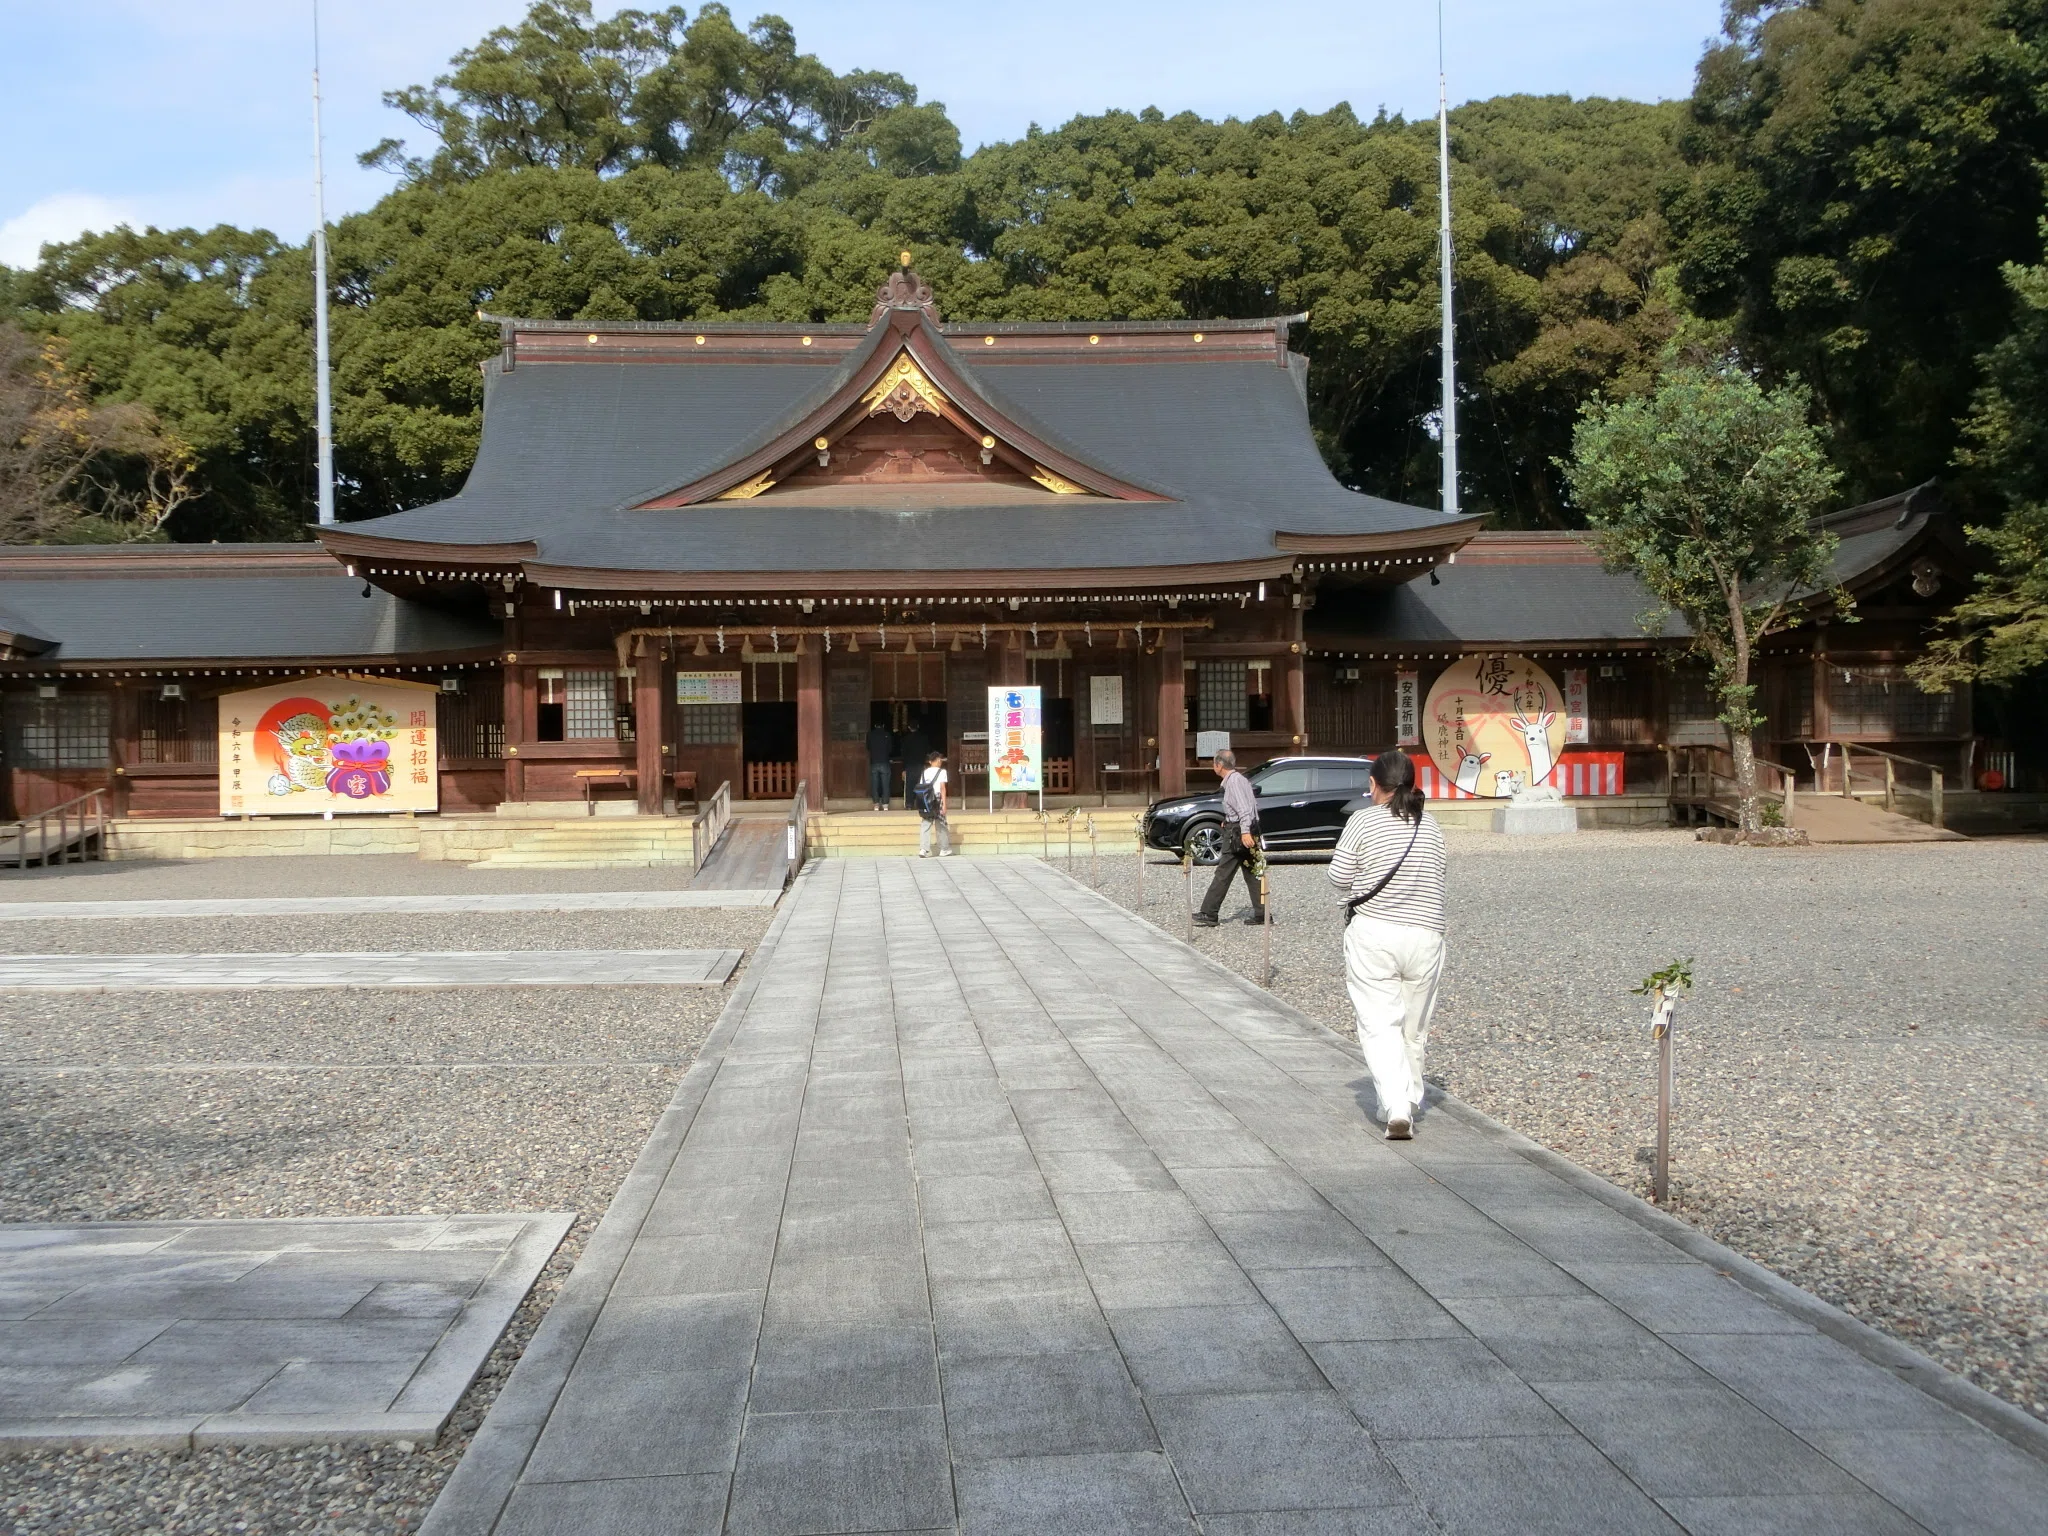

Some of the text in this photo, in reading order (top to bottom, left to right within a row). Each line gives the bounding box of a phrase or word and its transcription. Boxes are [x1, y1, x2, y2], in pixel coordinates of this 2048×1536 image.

[1475, 657, 1515, 696] 優
[1525, 668, 1534, 710] 令和六年
[1402, 681, 1414, 736] 安産祈願
[1569, 683, 1582, 731] 初宮詣
[410, 710, 429, 785] 開運招福
[1437, 713, 1449, 760] 砥鹿神社
[347, 774, 367, 796] 宝
